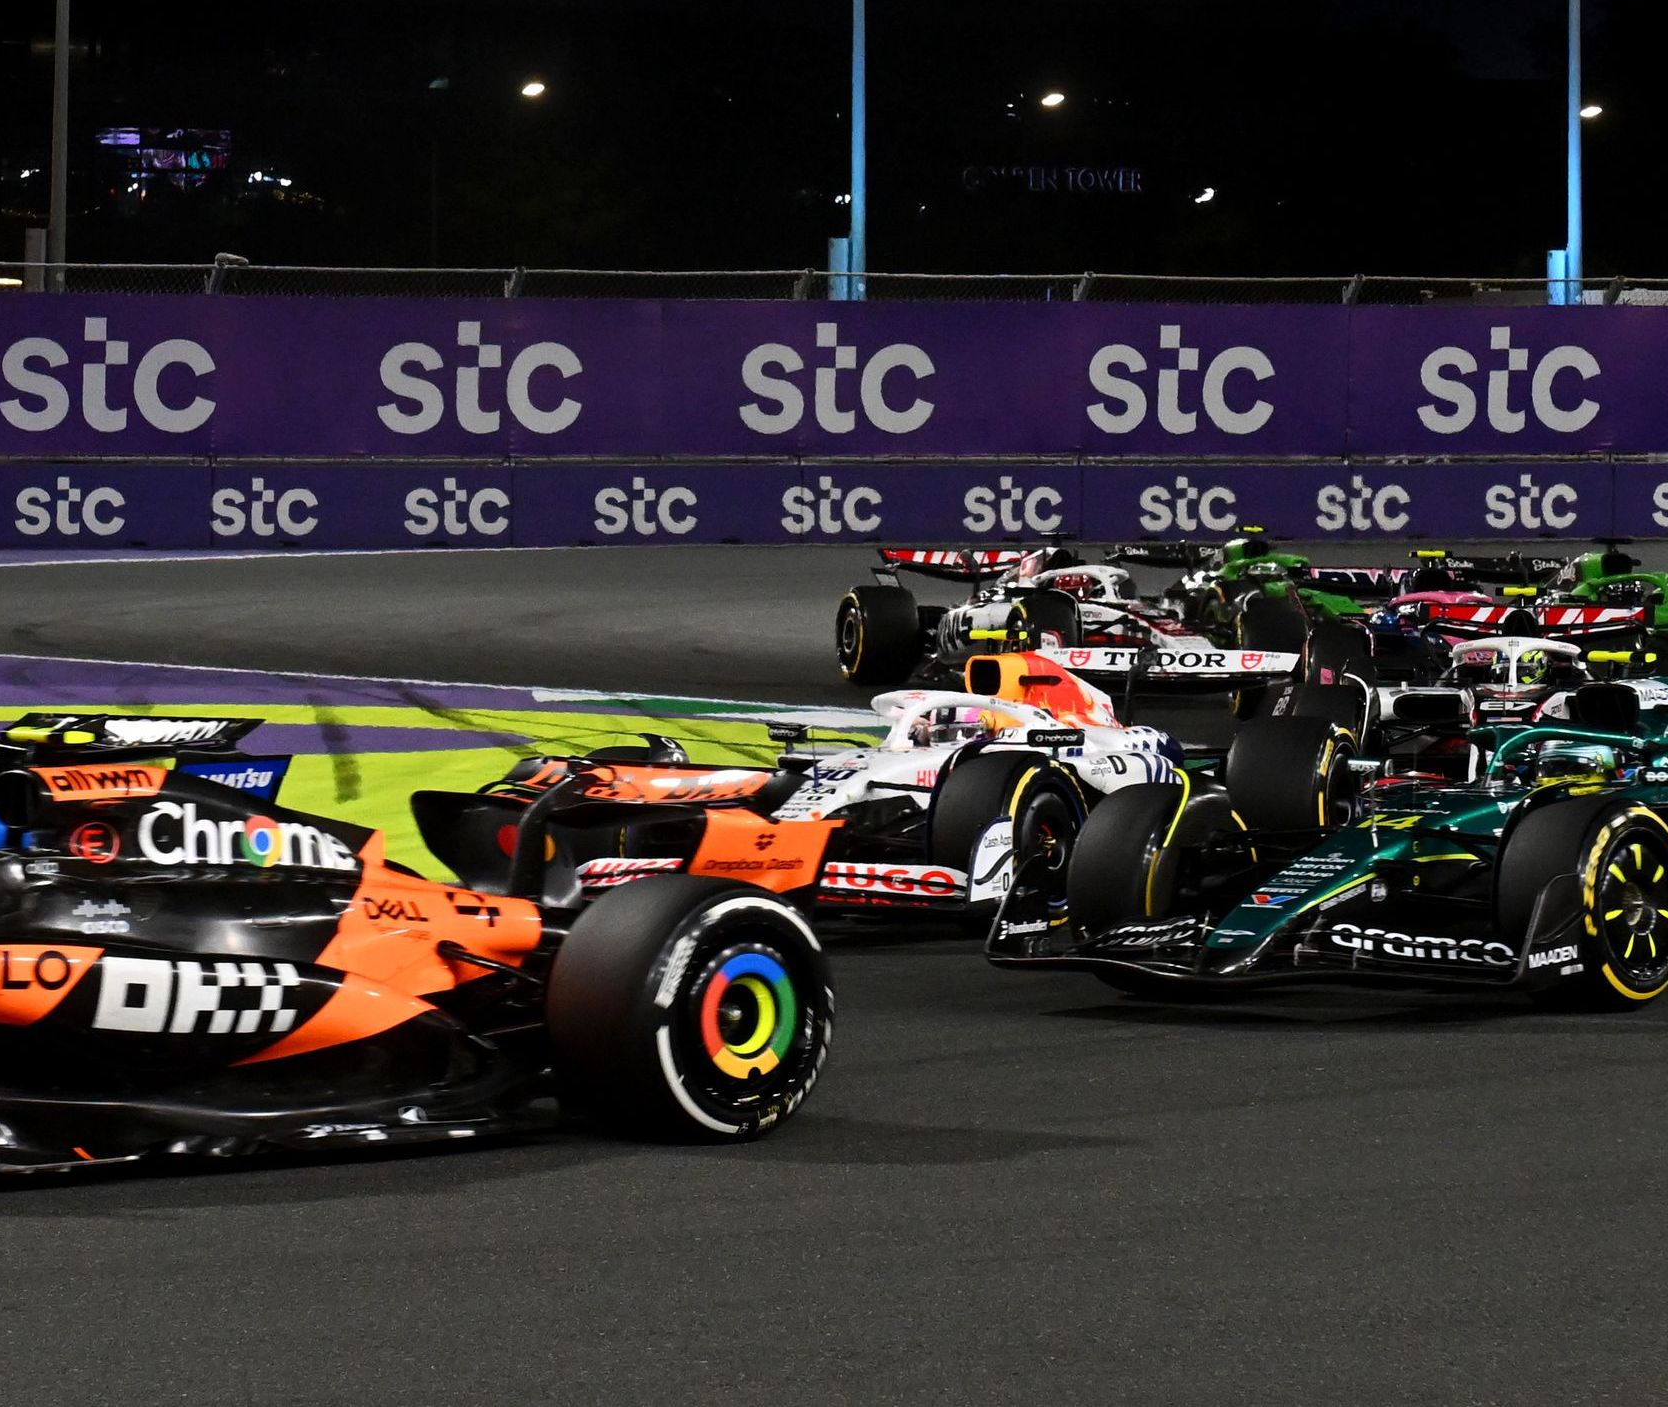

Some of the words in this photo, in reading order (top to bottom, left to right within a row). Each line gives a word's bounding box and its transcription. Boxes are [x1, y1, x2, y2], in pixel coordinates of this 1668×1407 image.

[1065, 166, 1143, 193] TOWER
[0, 317, 217, 433] stc
[377, 321, 583, 435] stc
[739, 323, 935, 435] stc
[1086, 325, 1276, 435] stc
[1417, 327, 1601, 434] stc
[15, 477, 126, 536] stc
[211, 477, 319, 536] stc
[404, 477, 510, 536] stc
[594, 477, 698, 535] stc
[781, 476, 883, 534] stc
[963, 476, 1063, 533] stc
[1139, 476, 1238, 532] stc
[1316, 474, 1411, 532] stc
[1485, 474, 1578, 530] stc
[1532, 559, 1562, 572] Stake
[1104, 651, 1227, 669] TUDOR
[51, 769, 154, 796] allwyn
[1355, 814, 1425, 830] 14
[704, 859, 764, 871] Dropbox
[770, 858, 804, 870] Dash
[1290, 863, 1347, 871] xerox
[1298, 856, 1357, 864] NexGen
[1278, 870, 1335, 878] NetApp
[363, 896, 430, 923] DELL
[1332, 923, 1514, 966] aramco
[1527, 944, 1578, 970] MAADEN
